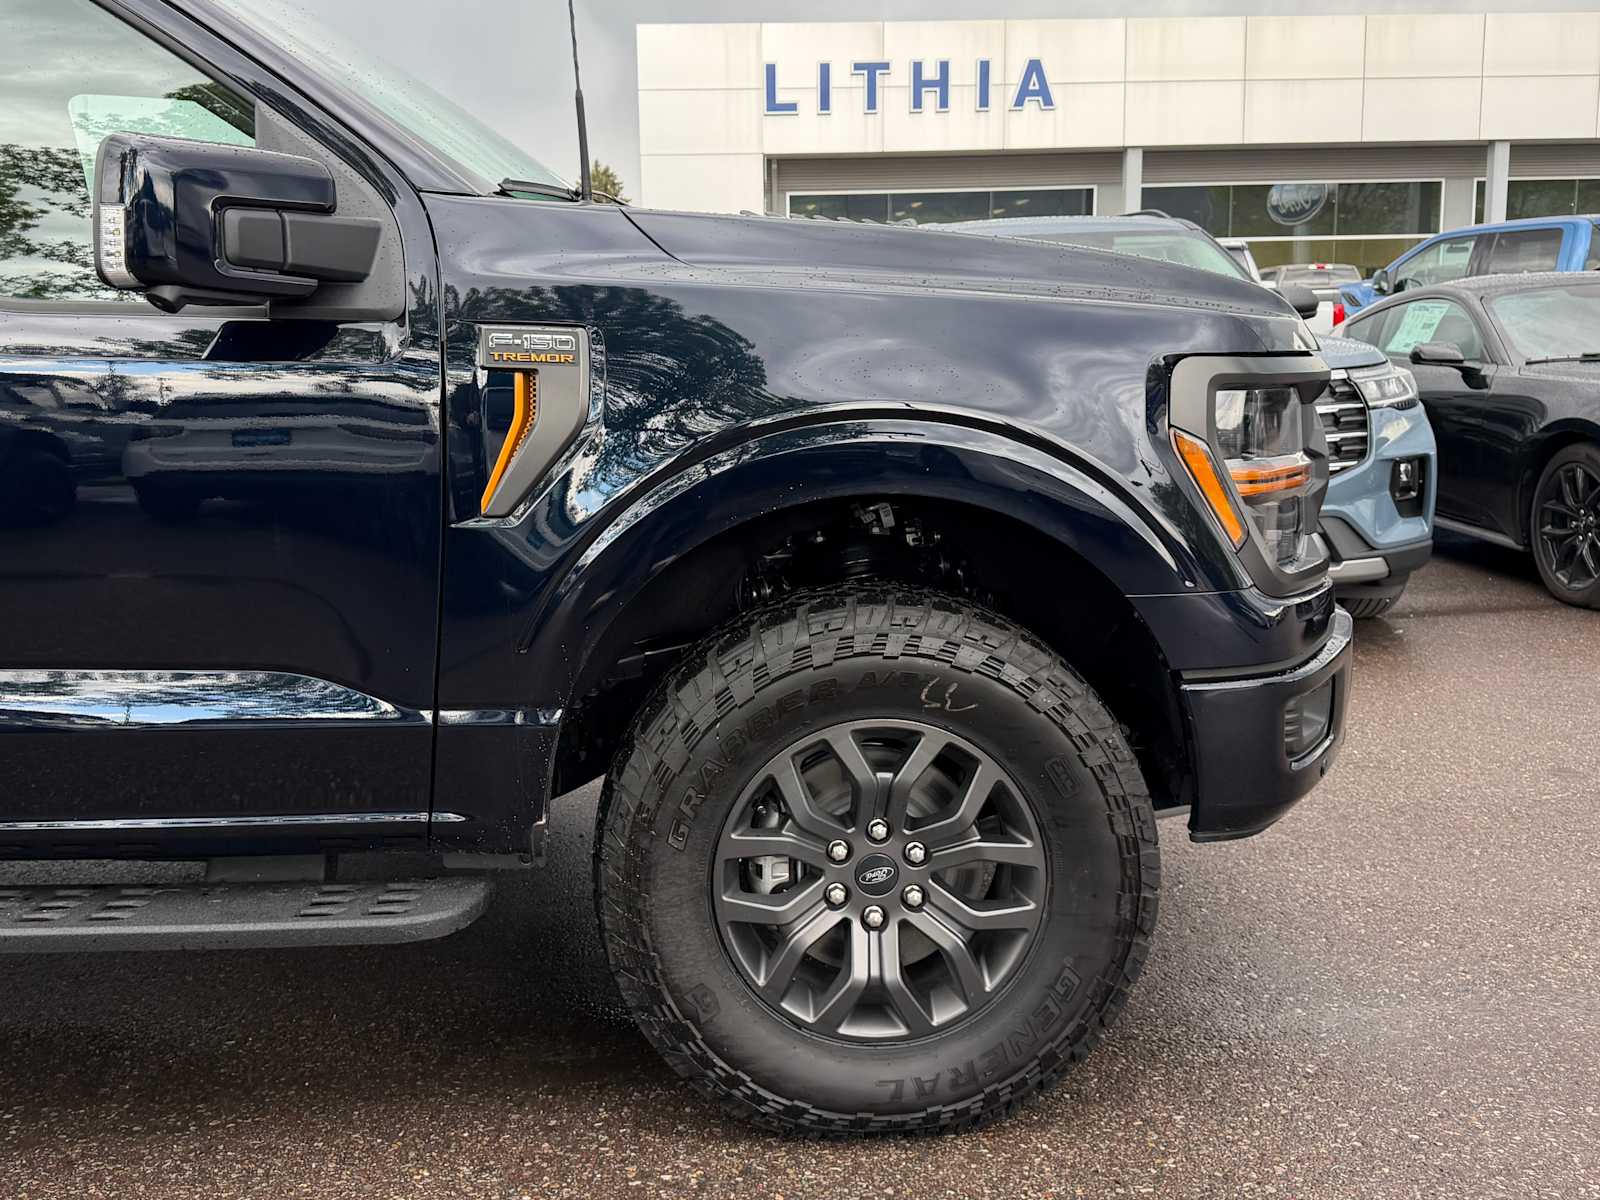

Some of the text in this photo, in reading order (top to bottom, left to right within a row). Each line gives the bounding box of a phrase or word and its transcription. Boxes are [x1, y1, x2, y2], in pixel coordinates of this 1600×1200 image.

[763, 57, 1056, 115] LITHIA
[488, 332, 576, 351] F-150
[489, 351, 576, 363] TREMOR
[666, 678, 840, 852] GRABBER
[863, 868, 890, 882] Ford
[873, 966, 1082, 1102] GENERAL
